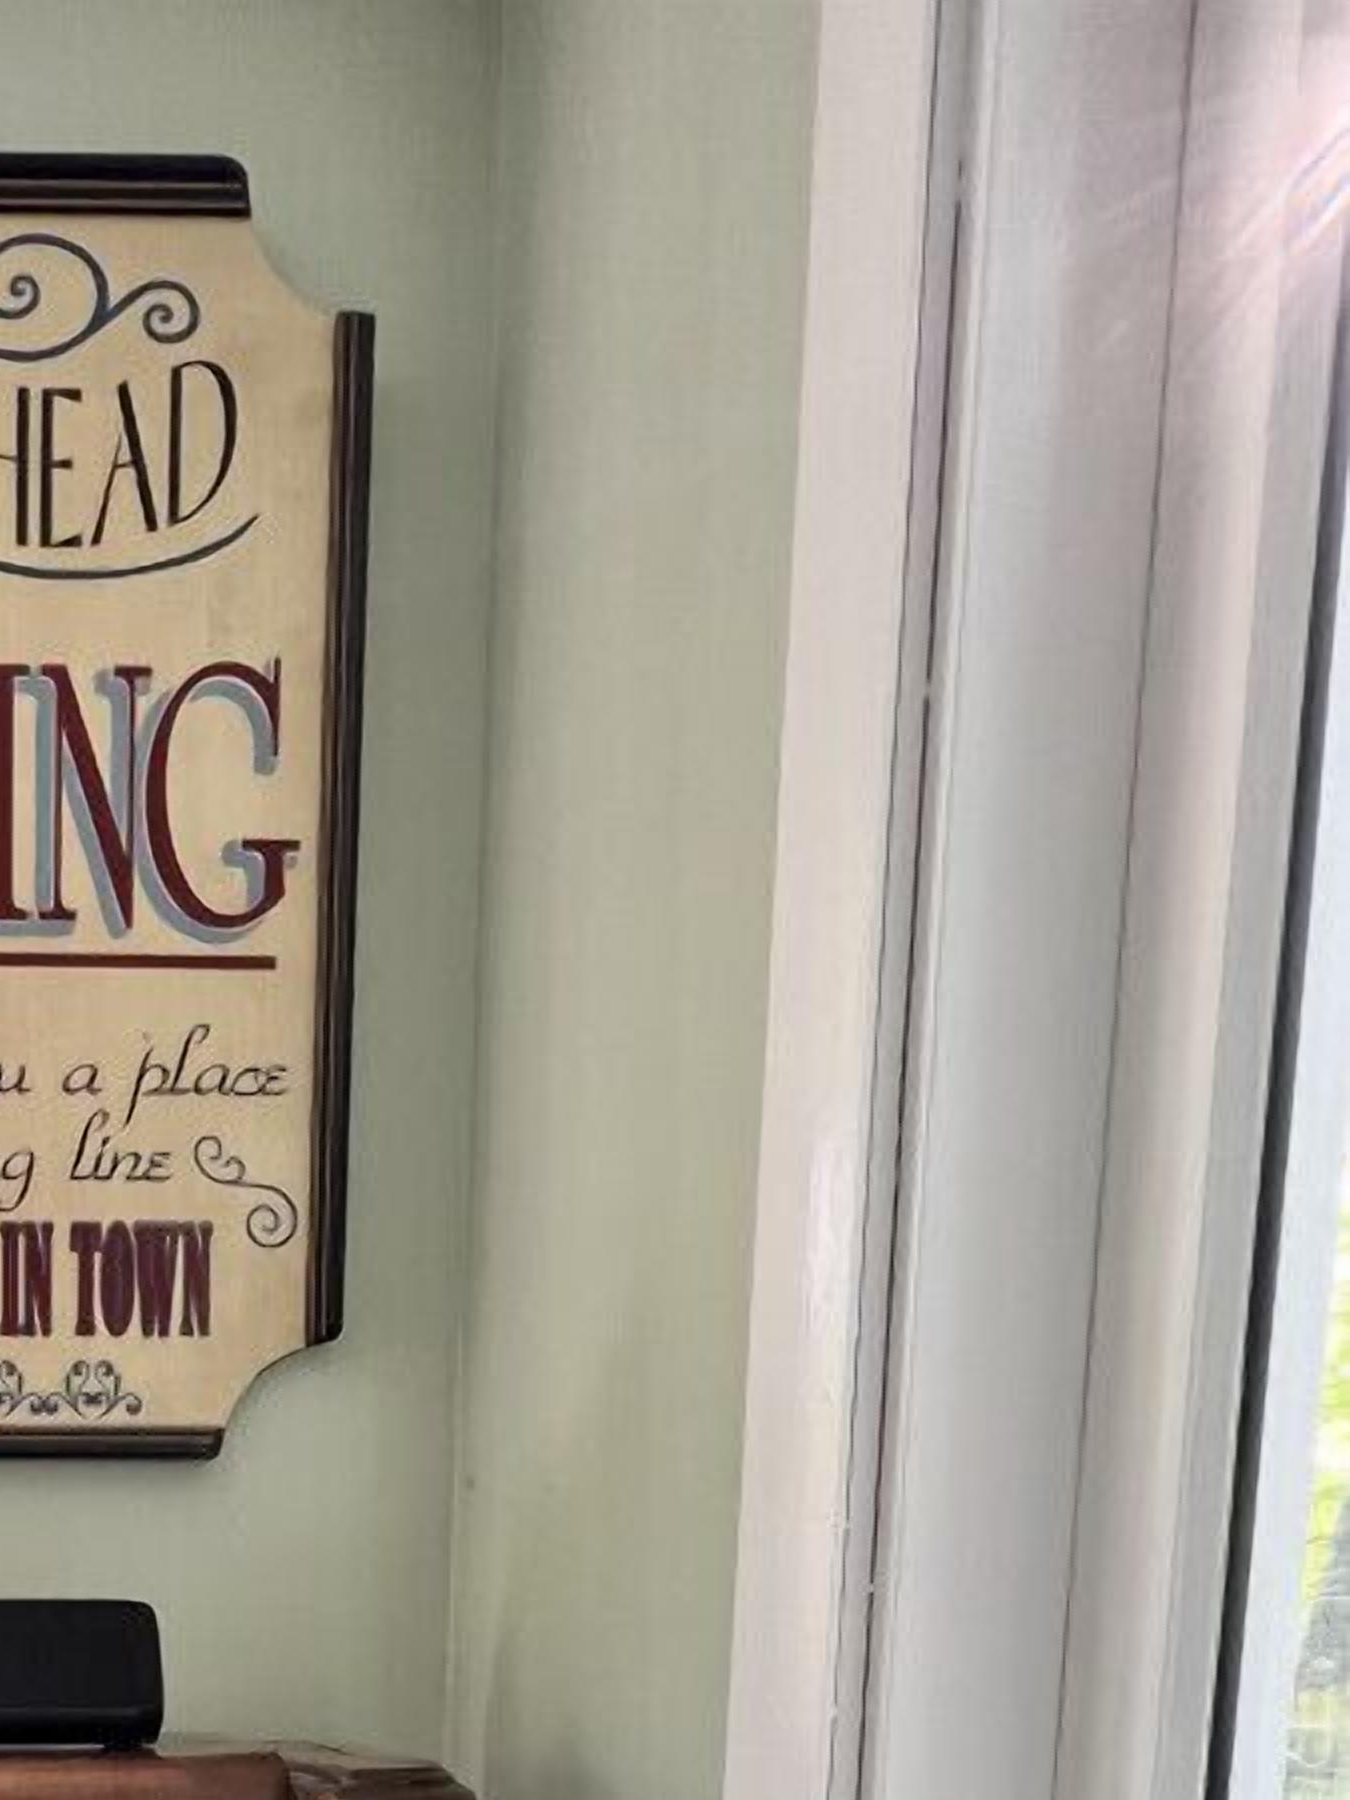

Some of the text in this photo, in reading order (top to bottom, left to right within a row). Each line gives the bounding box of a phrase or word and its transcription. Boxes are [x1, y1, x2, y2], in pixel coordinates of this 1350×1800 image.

[62, 1062, 102, 1095] a
[124, 1024, 290, 1124] place
[69, 1109, 174, 1182] line
[0, 1221, 55, 1337] IN
[69, 1221, 214, 1338] TOWN
